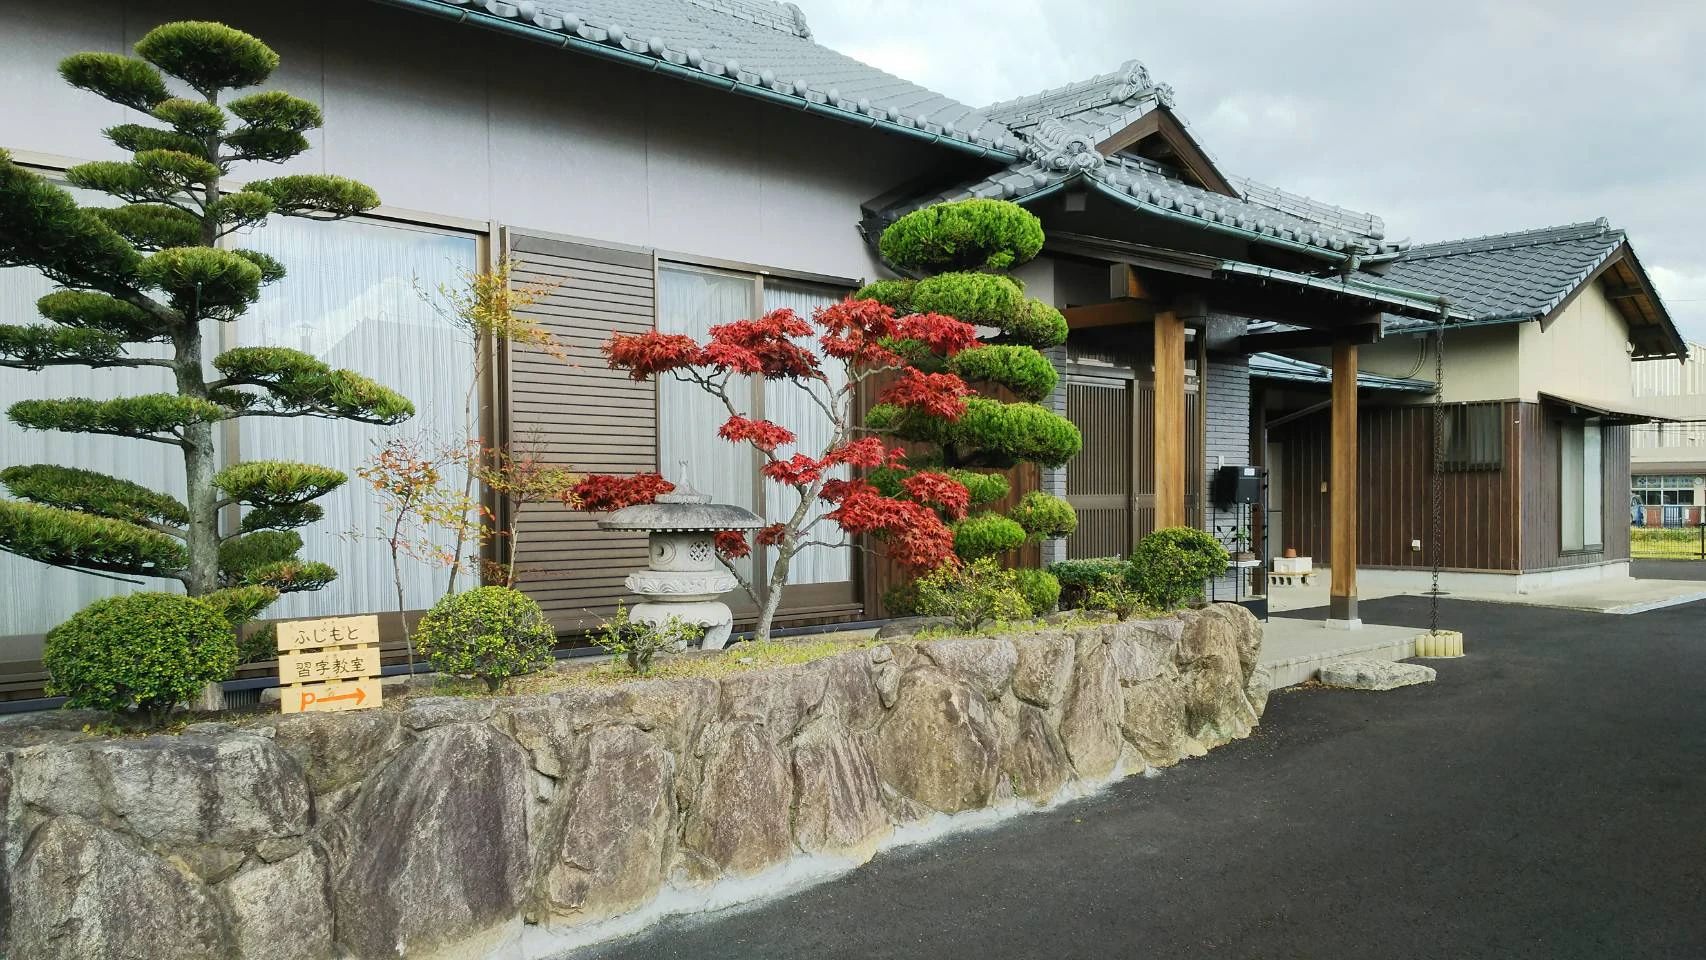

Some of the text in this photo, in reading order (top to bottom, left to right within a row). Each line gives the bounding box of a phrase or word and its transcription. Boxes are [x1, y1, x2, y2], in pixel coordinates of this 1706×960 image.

[295, 626, 359, 644] ふじもと
[296, 657, 365, 677] 習字教室
[301, 692, 316, 712] P
